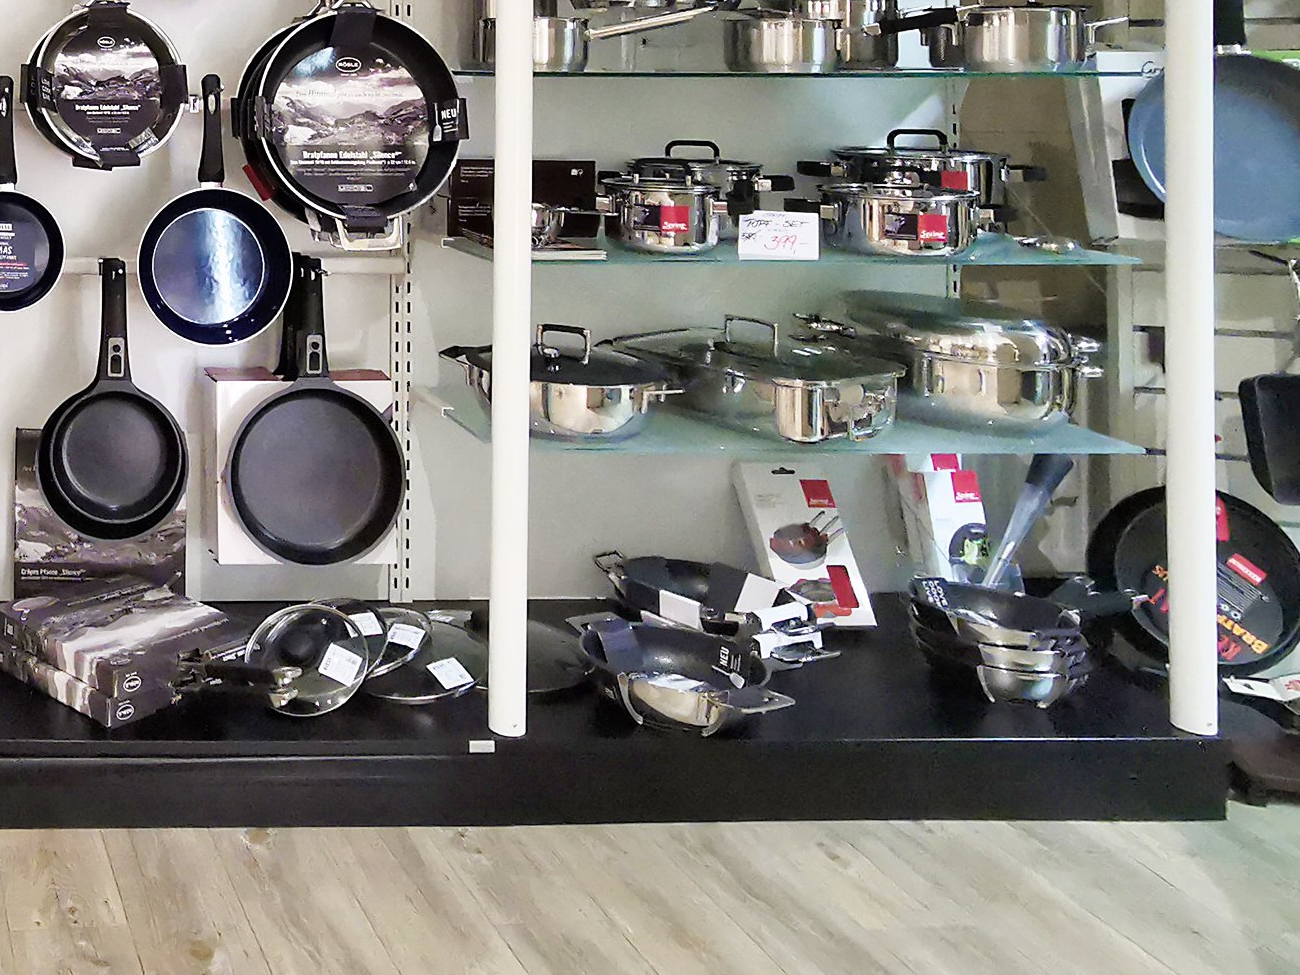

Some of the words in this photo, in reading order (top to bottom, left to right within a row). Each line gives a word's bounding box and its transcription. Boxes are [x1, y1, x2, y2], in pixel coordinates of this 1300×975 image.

[338, 60, 360, 68] RÖSLE
[441, 108, 457, 120] NEU
[302, 151, 338, 160] Bratpfanne
[339, 151, 368, 159] Edelstahl
[782, 220, 811, 228] SET
[720, 646, 730, 667] NEU
